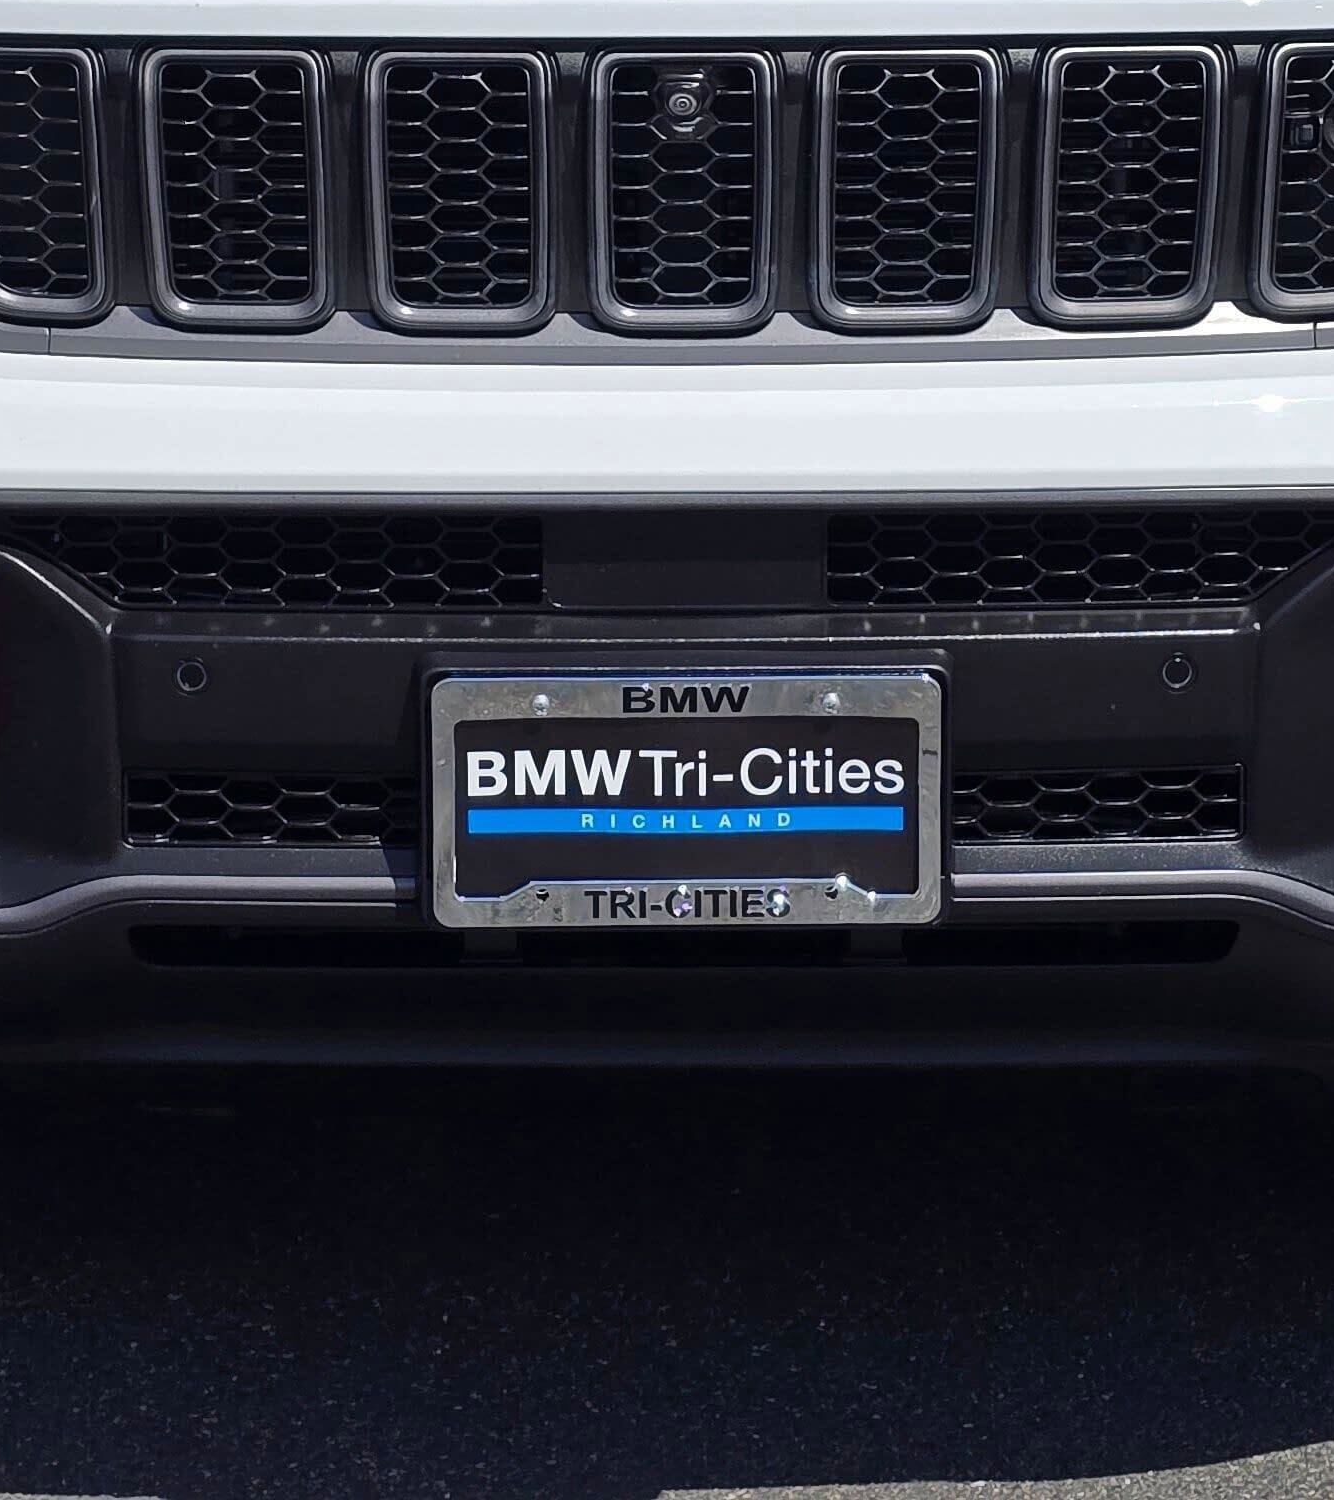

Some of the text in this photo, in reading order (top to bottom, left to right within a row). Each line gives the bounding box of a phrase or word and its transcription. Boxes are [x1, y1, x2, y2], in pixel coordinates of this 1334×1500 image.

[622, 686, 750, 713] BMW
[467, 747, 905, 797] BMW Tri-Cities
[581, 812, 792, 829] RICHLAND
[584, 889, 792, 919] TRI-CITIES
